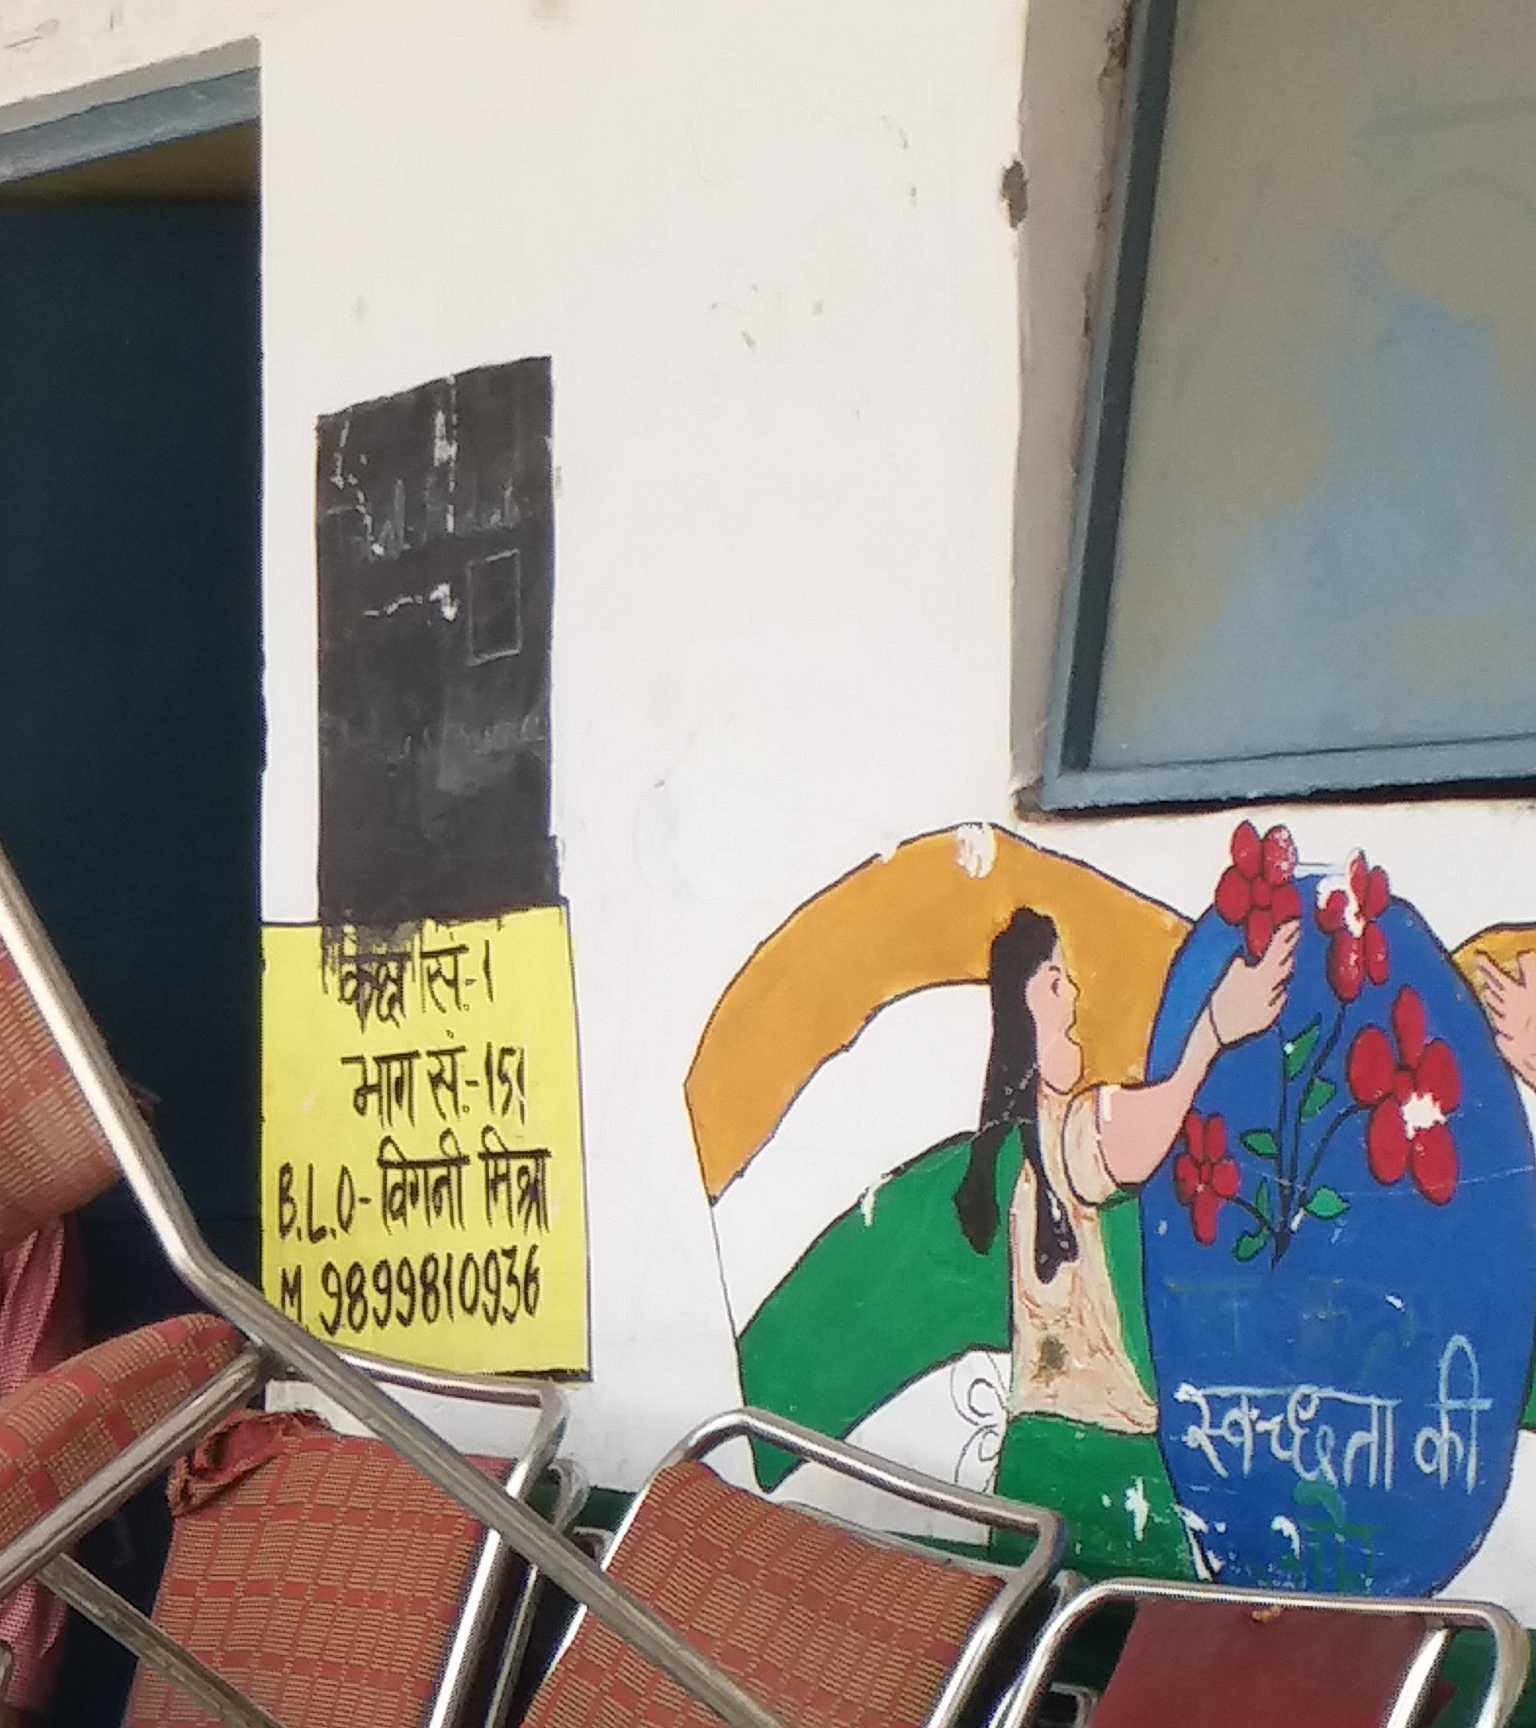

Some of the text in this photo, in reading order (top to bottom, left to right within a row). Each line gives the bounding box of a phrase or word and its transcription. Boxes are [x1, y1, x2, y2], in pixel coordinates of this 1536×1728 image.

[341, 1049, 420, 1130] भाग
[319, 1243, 541, 1338] 9899810936
[1414, 1334, 1495, 1494] की
